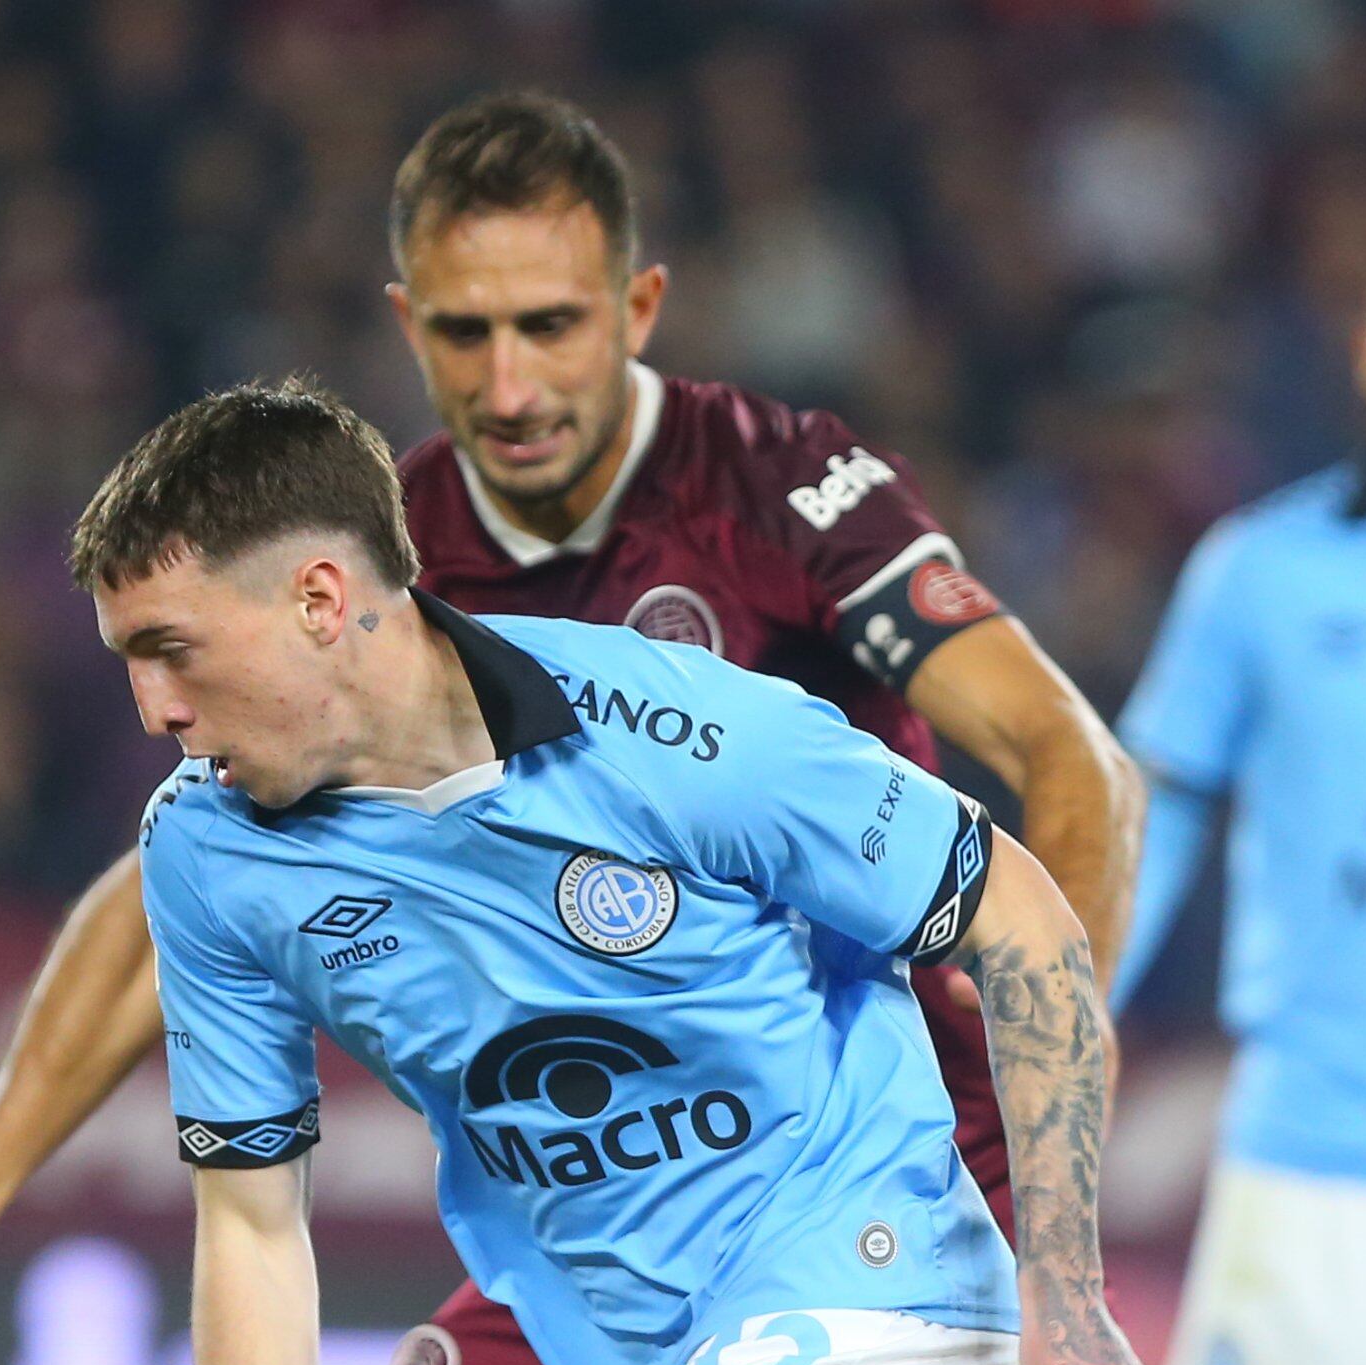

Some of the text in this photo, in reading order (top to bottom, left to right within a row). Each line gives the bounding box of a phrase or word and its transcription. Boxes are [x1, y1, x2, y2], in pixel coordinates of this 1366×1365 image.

[554, 674, 725, 762] ANOS
[319, 935, 399, 971] umbro
[459, 1089, 753, 1189] Macro
